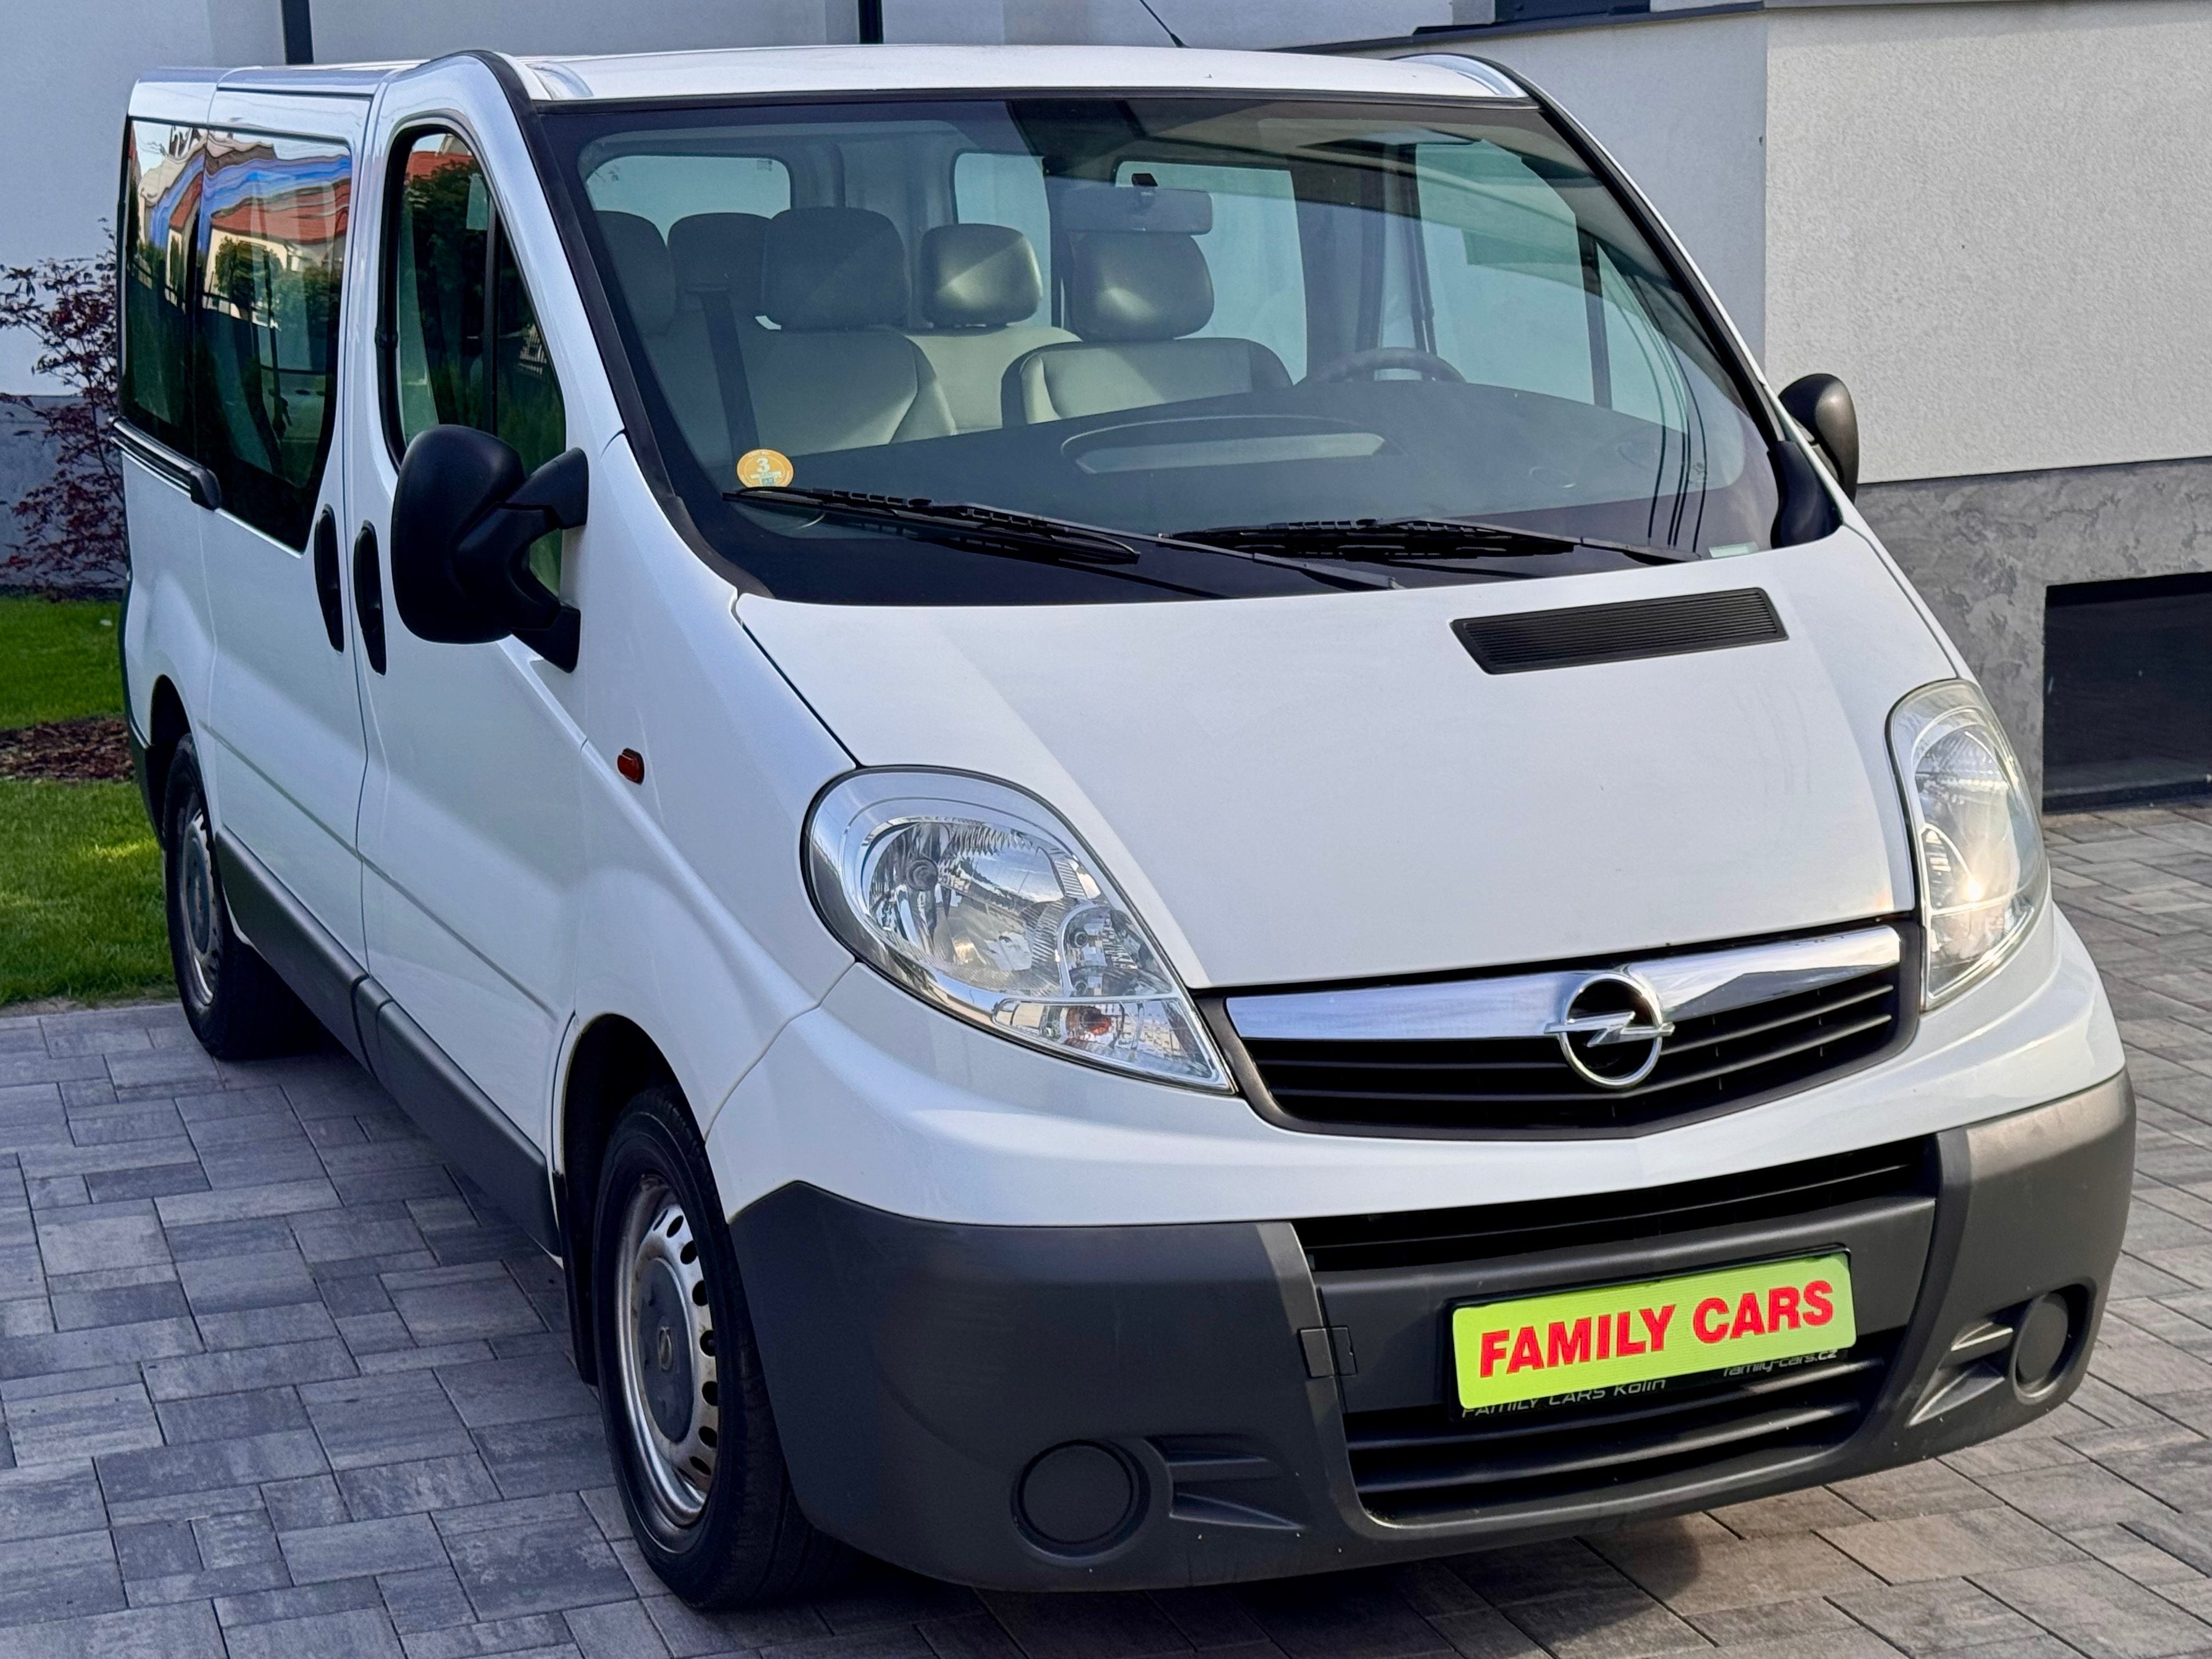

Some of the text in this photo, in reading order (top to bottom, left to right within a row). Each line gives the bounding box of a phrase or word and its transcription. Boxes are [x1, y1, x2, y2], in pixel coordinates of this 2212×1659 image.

[757, 458, 770, 473] 3
[1480, 1280, 1834, 1378] FAMILY CARS
